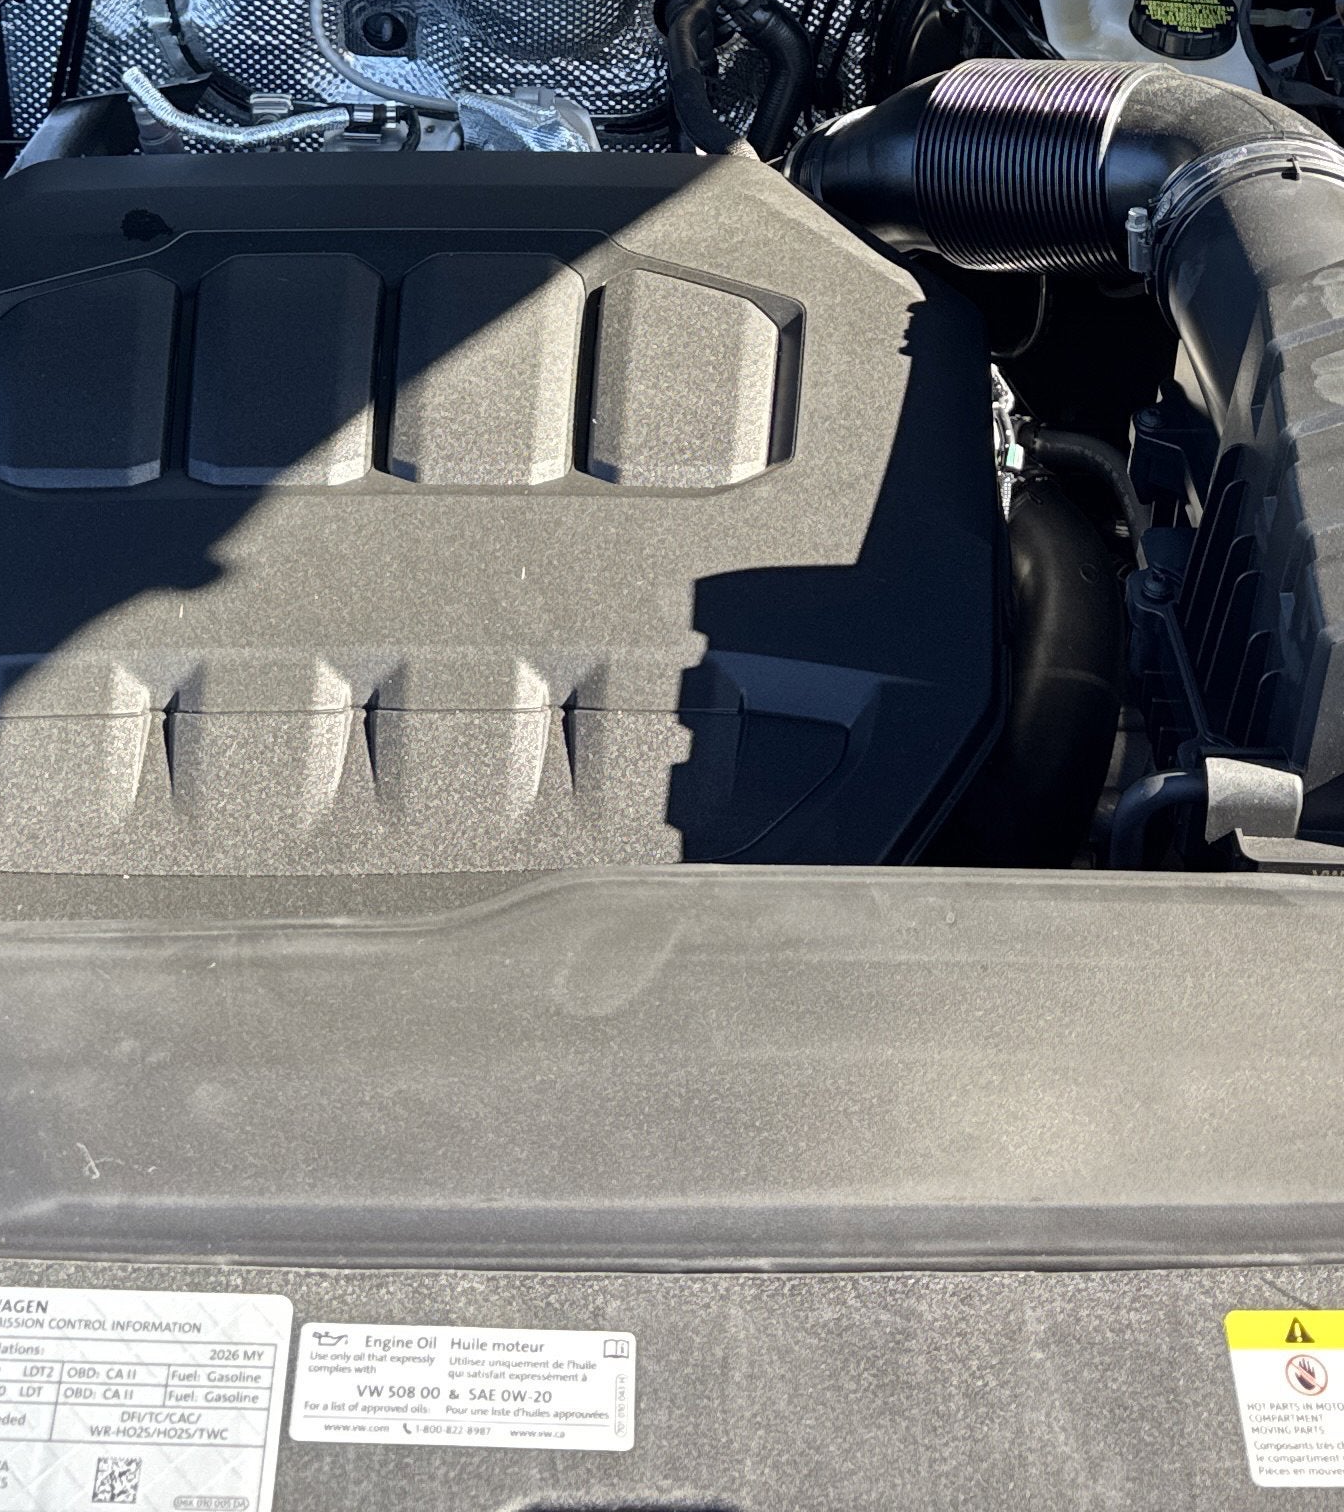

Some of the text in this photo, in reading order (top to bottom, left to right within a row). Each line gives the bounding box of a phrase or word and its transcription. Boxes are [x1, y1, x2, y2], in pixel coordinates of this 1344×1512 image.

[49, 1318, 106, 1331] CONTROL
[111, 1320, 202, 1334] INFORMATION
[365, 1335, 437, 1352] Engine Oil
[450, 1338, 544, 1353] Huile moteur
[209, 1349, 264, 1361] 2026 MY
[310, 1352, 435, 1366] Use only oil that expressly
[308, 1364, 377, 1375] complies with
[449, 1357, 486, 1367] Utilisez
[488, 1358, 549, 1370] uniquement
[552, 1359, 565, 1369] de
[22, 1366, 54, 1378] LDT2
[67, 1367, 99, 1379] OBD:
[106, 1368, 123, 1379] CA
[171, 1370, 261, 1384] Fuel: Gasoline
[448, 1370, 464, 1380] qui
[466, 1370, 506, 1380] satisfait
[19, 1385, 43, 1397] LDT
[63, 1387, 96, 1399] OBD:
[102, 1388, 120, 1400] CA
[168, 1390, 259, 1404] Fuel: Gasoline
[356, 1385, 552, 1404] VW 508 00 & SAE 0W-20
[304, 1401, 320, 1411] For
[331, 1401, 346, 1411] list
[347, 1402, 359, 1412] of
[361, 1403, 408, 1415] approved
[445, 1405, 468, 1415] Pour
[470, 1408, 489, 1416] une
[1247, 1402, 1266, 1411] HOT
[1269, 1402, 1300, 1411] PARTS
[1302, 1402, 1313, 1411] IN
[120, 1411, 202, 1424] DFI/TC/CAC/
[1249, 1414, 1324, 1423] COMPARTMENT
[324, 1423, 390, 1433] www.vw.com
[510, 1429, 566, 1438] www.vw.ca
[1251, 1426, 1325, 1435] MOVING PARTS
[1254, 1441, 1314, 1451] Composants
[1256, 1454, 1265, 1462] le
[1268, 1454, 1340, 1464] compartiment
